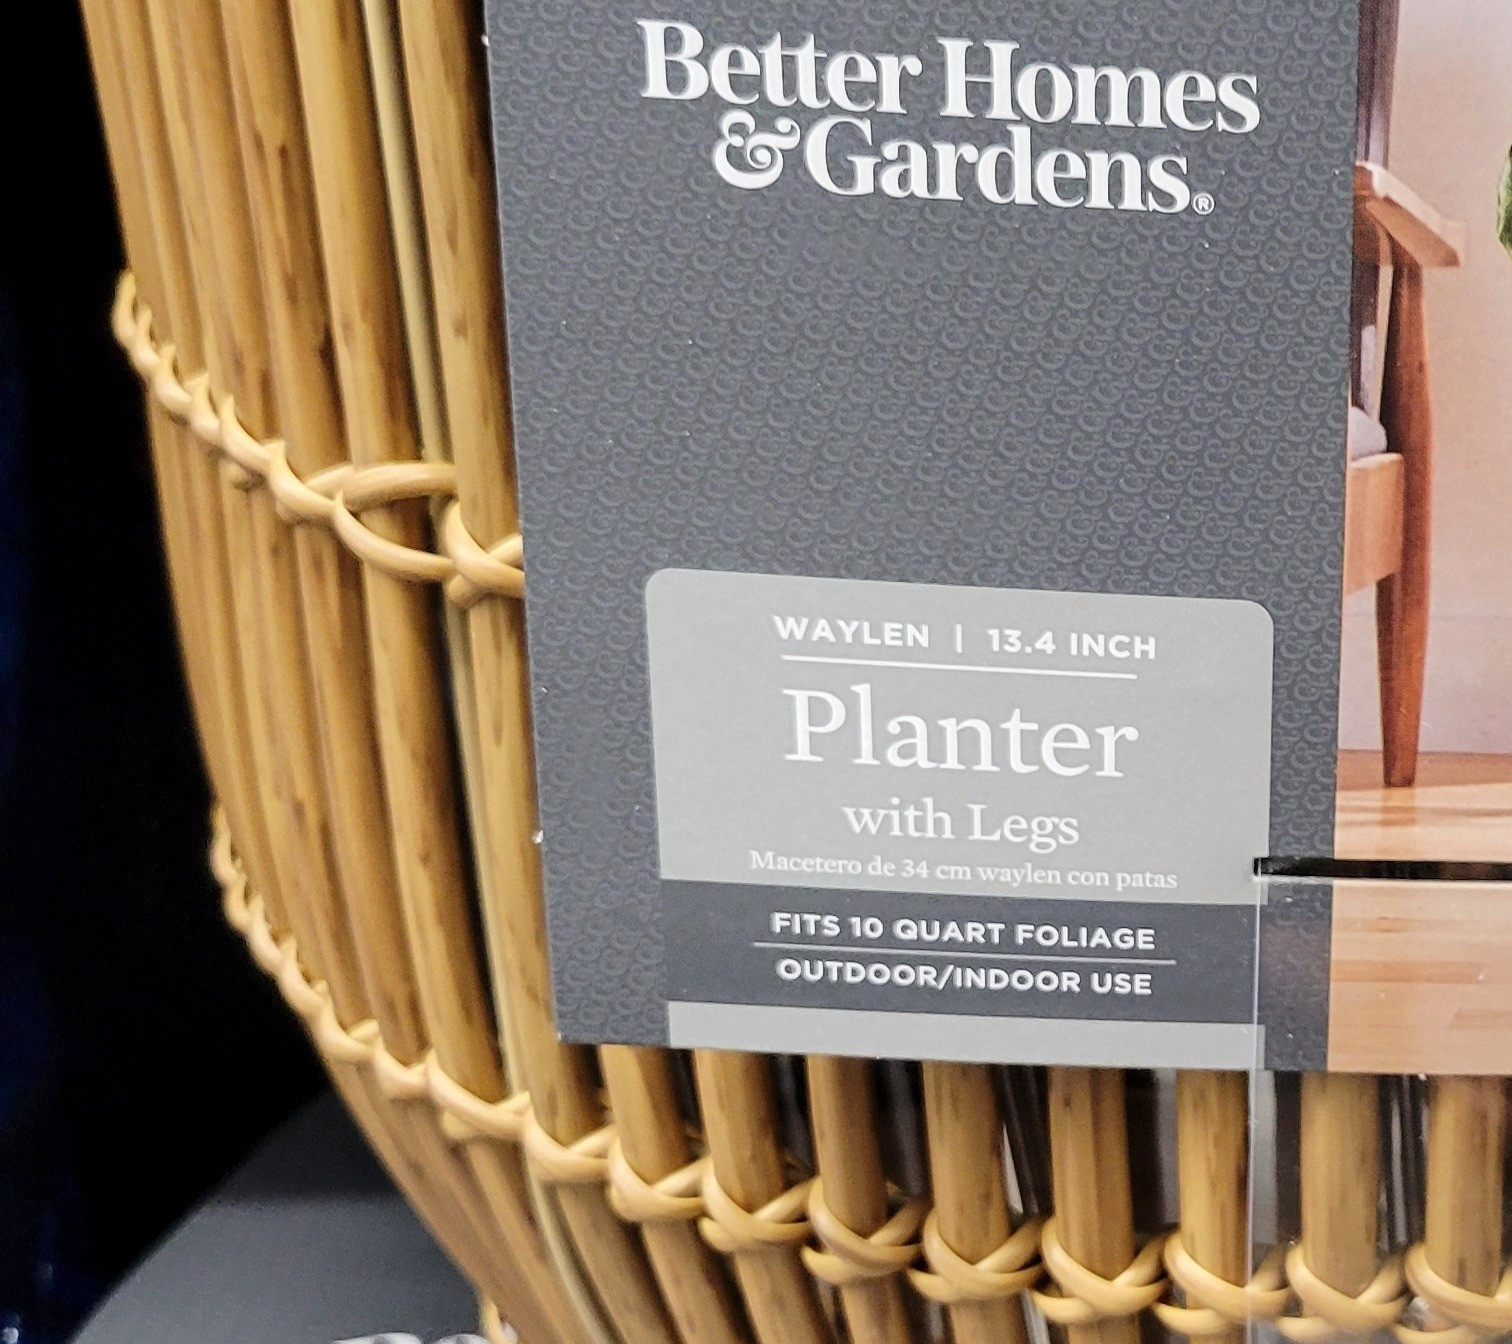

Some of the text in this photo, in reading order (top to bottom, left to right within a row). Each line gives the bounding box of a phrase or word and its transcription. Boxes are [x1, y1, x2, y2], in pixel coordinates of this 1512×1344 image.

[635, 18, 1262, 134] Better Homes
[773, 613, 930, 649] WAYLEN
[988, 627, 1057, 655] 13.4
[1069, 632, 1157, 660] INCH
[781, 683, 1140, 779] Planter
[841, 797, 1080, 854] with Legs
[749, 850, 1178, 894] Macetero de 34 cm waylen con patas
[770, 912, 1156, 951] FITS 10 QUART FOLIAGE
[775, 958, 1153, 996] OUTDOOR/INDOOR USE
